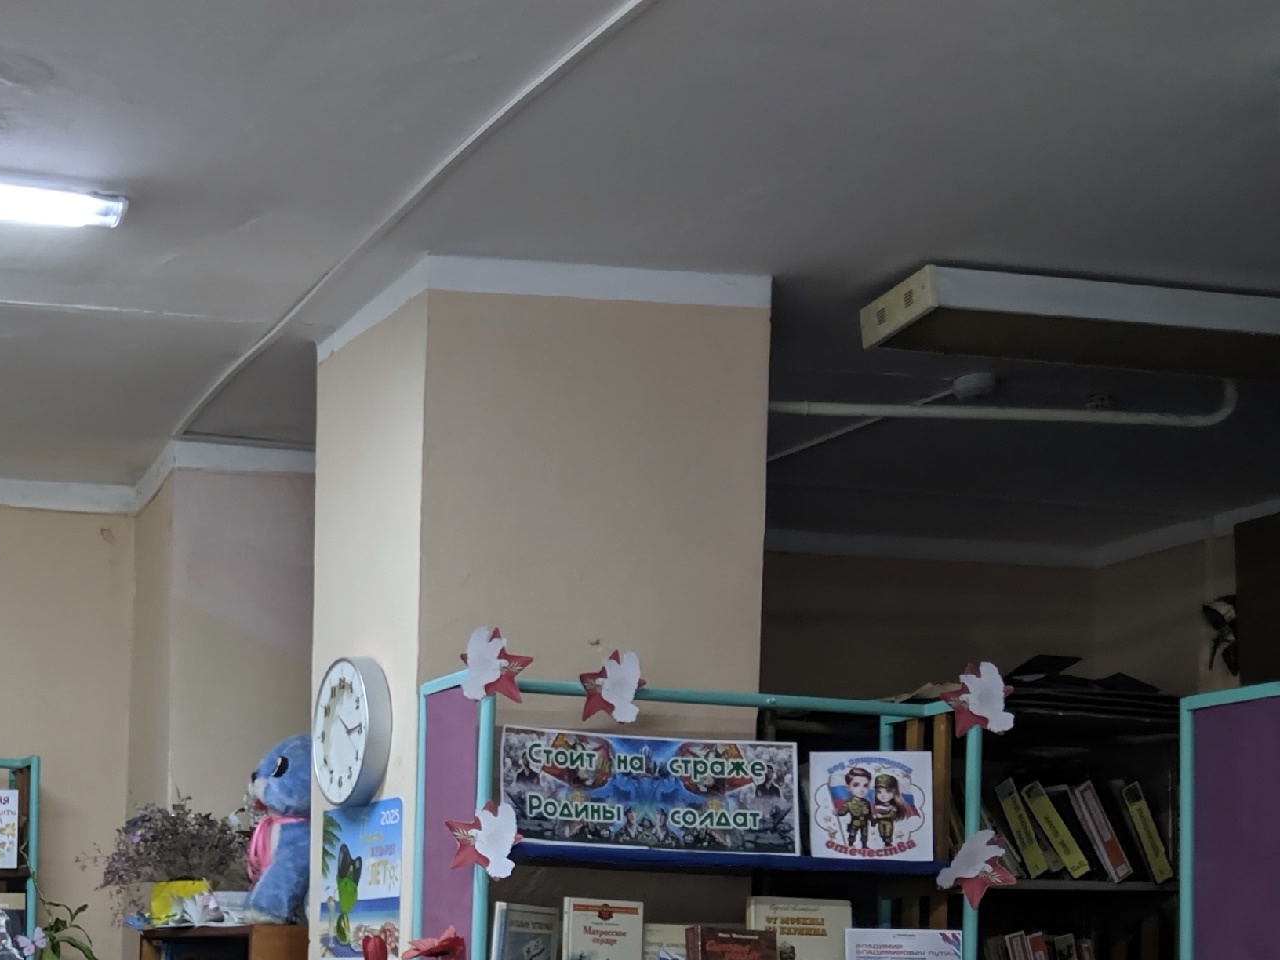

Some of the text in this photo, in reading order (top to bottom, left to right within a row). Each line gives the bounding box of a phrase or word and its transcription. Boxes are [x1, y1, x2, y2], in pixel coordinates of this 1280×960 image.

[528, 743, 767, 780] Стоит на страже
[528, 794, 762, 829] Родины солдат
[825, 840, 917, 858] отечества
